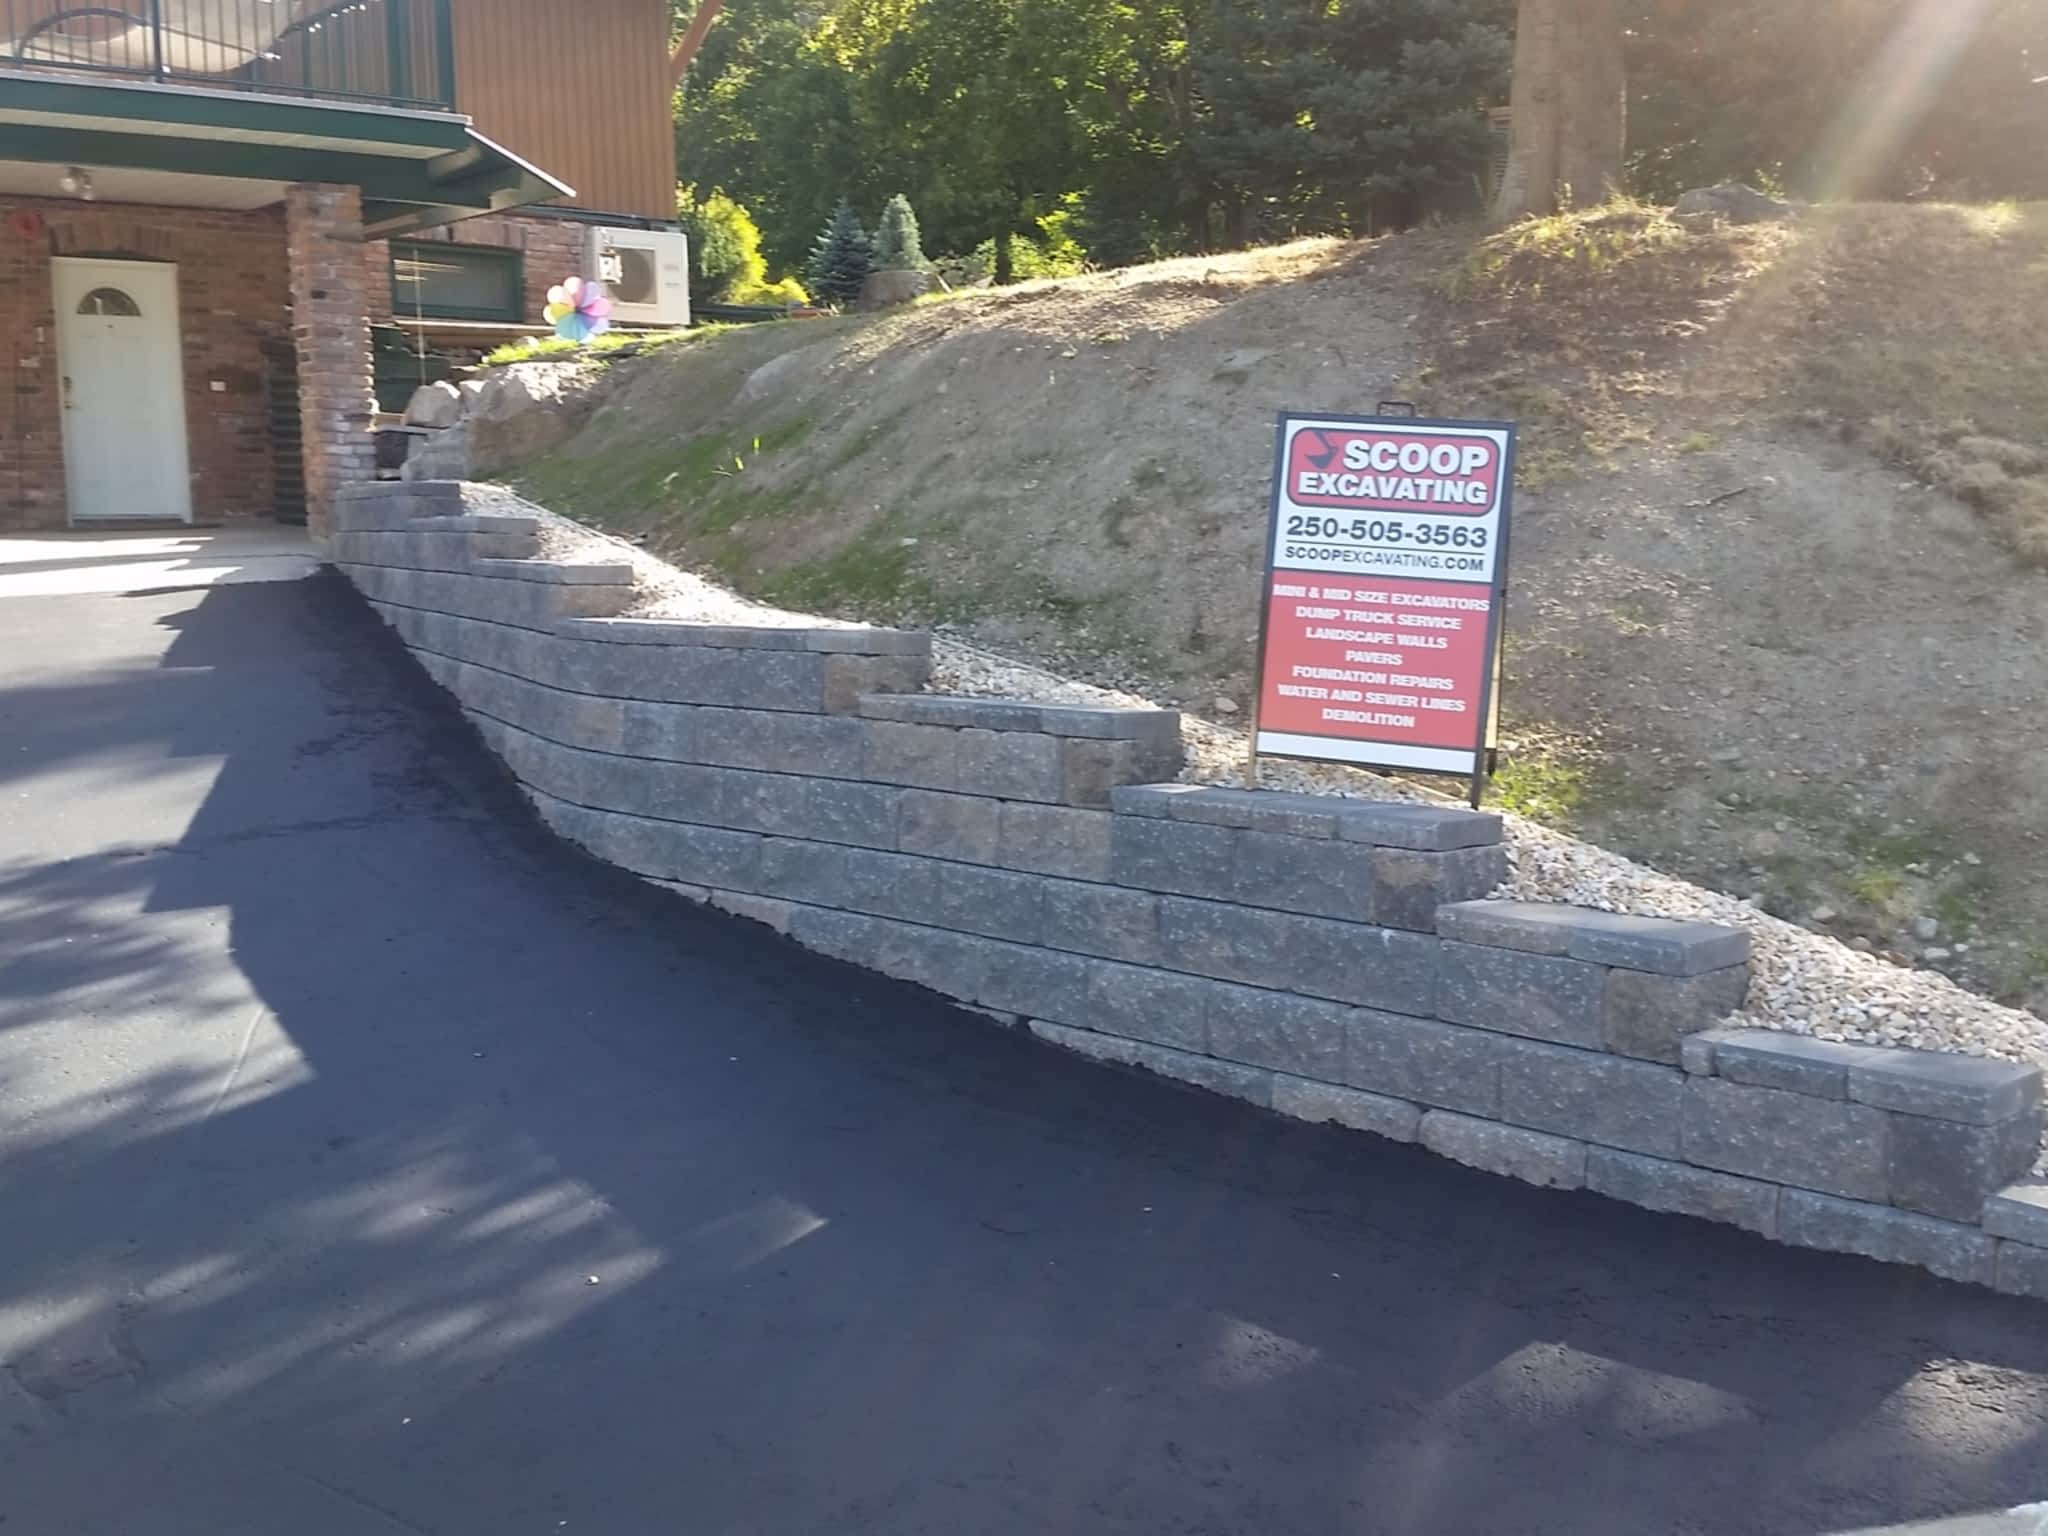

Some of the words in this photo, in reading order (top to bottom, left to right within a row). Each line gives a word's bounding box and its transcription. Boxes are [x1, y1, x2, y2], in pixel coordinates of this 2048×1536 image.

[1343, 439, 1489, 476] SCOOP
[1298, 471, 1488, 505] EXCAVATING
[1287, 515, 1487, 548] 250-505-3563
[1285, 546, 1484, 571] SCOOPEXCAVATING.COM
[1273, 584, 1306, 598] MINI
[1308, 587, 1320, 599] &
[1323, 587, 1351, 601] MID
[1354, 589, 1388, 604] SIZE
[1391, 592, 1490, 612] EXCAVATORS
[1296, 606, 1340, 621] DUMP
[1343, 609, 1394, 625] TRUCK
[1396, 613, 1462, 630] SERVICE
[1306, 627, 1394, 645] LANDSCAPE
[1396, 633, 1448, 649] WALLS
[1345, 650, 1403, 666] PAVERS
[1292, 665, 1387, 685] FOUNDATION
[1389, 674, 1454, 690] REPAIRS
[1278, 683, 1329, 699] WATER
[1330, 687, 1363, 702] AND
[1365, 690, 1419, 708] SEWER
[1421, 696, 1466, 712] LINES
[1322, 708, 1415, 728] DEMOLITION
